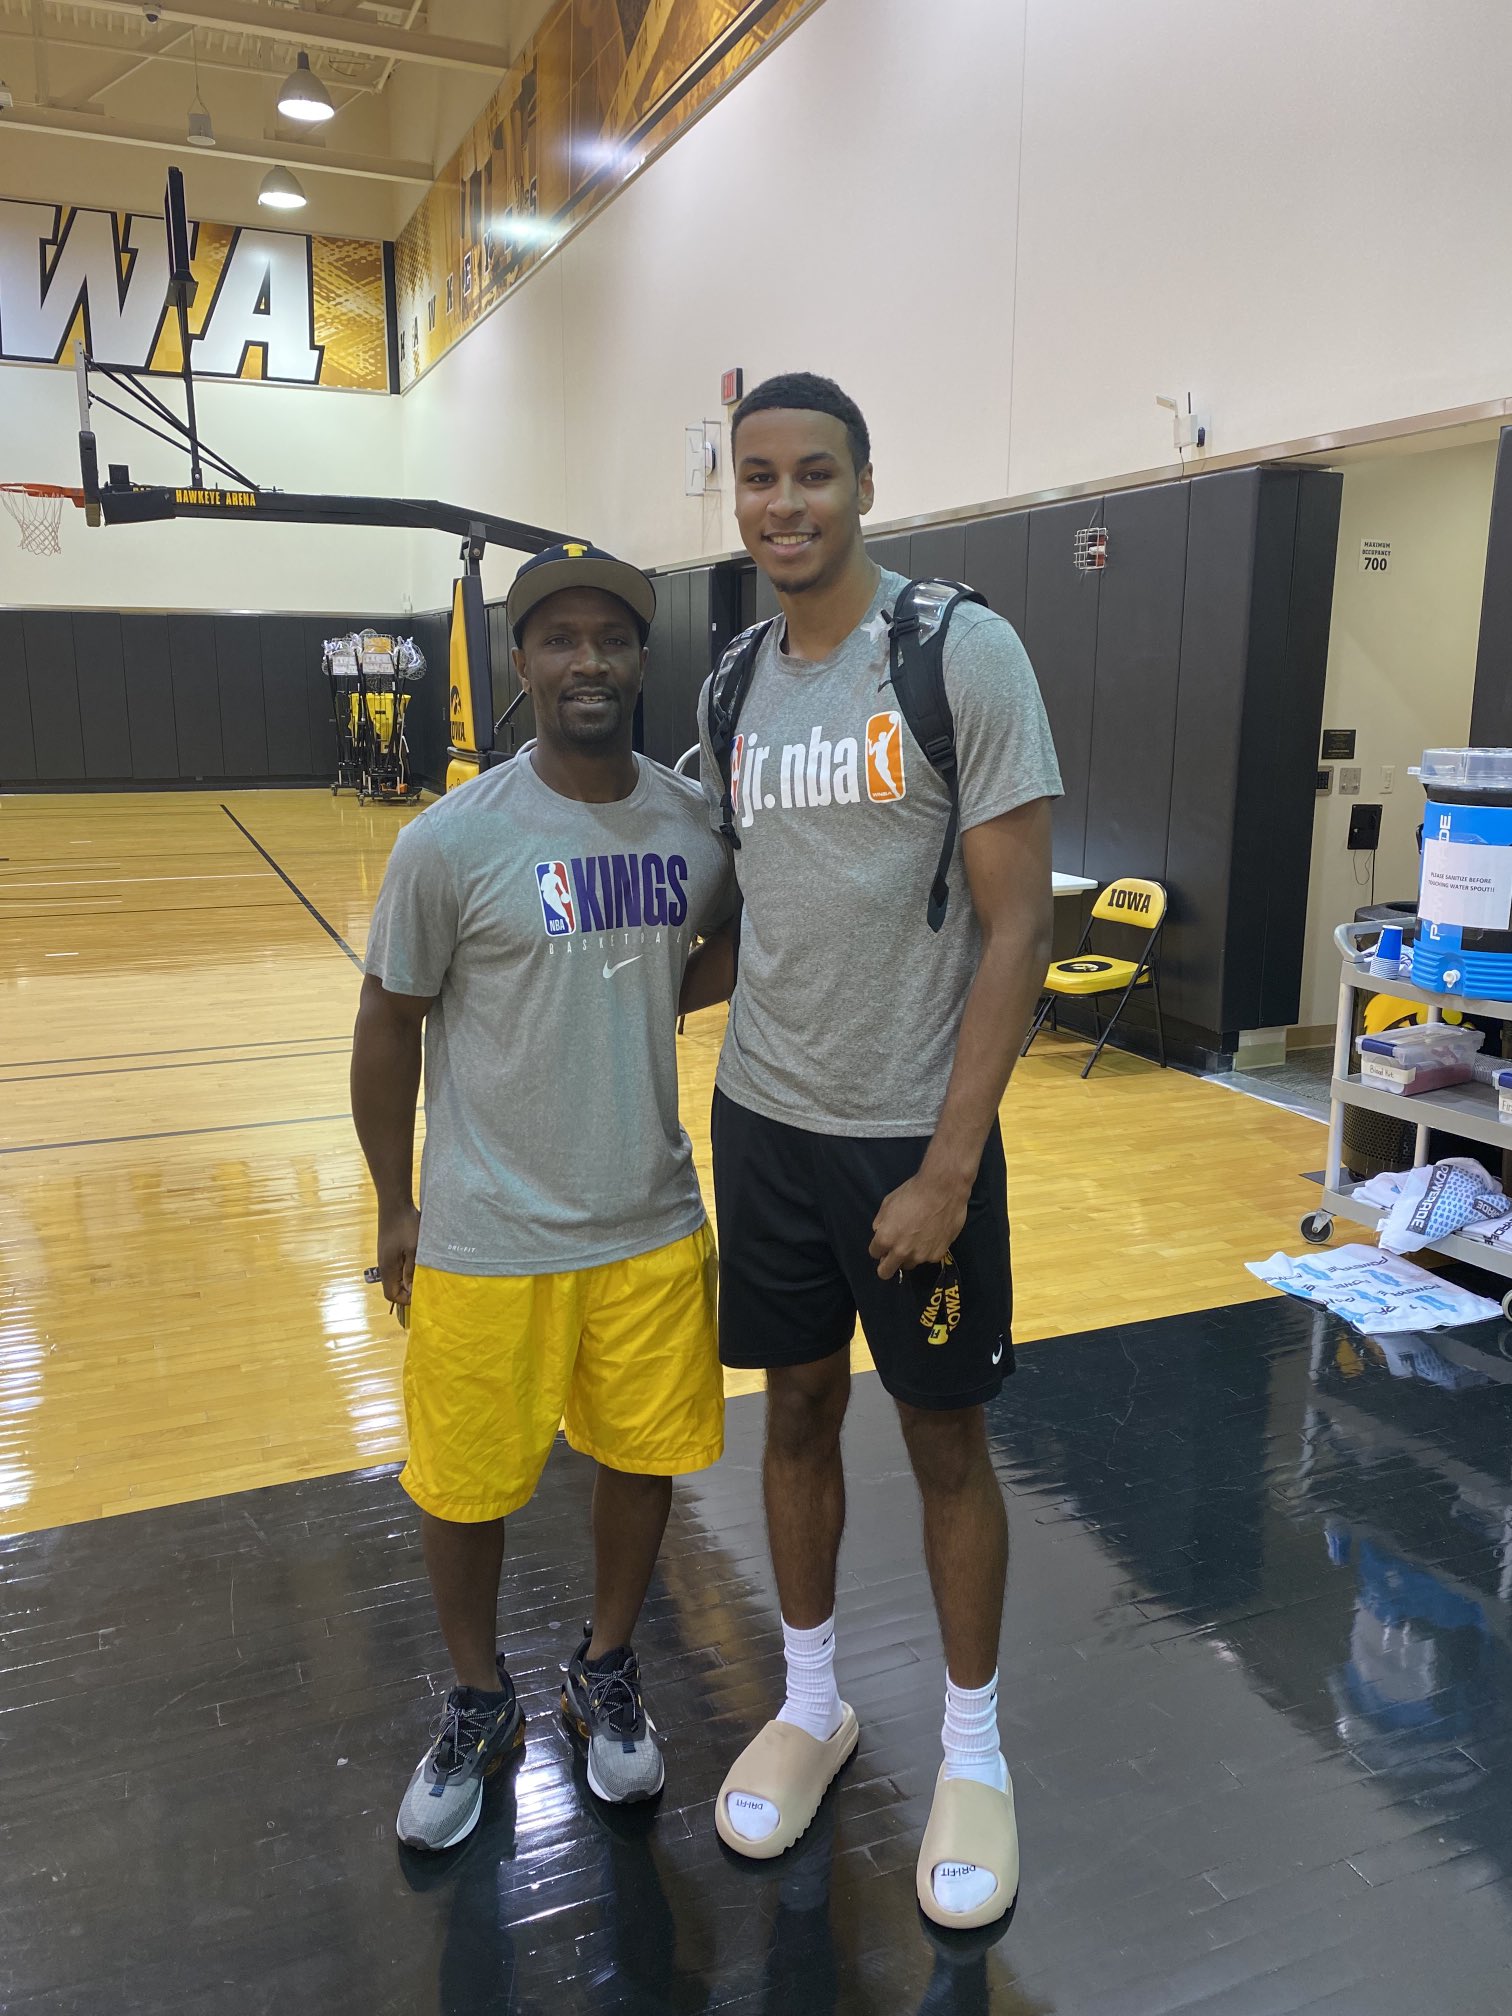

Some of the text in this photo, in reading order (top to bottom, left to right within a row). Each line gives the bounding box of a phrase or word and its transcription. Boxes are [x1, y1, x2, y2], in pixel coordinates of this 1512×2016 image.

[175, 489, 257, 507] HAWKEYE ARENA
[1364, 557, 1388, 571] 700
[1430, 872, 1444, 880] PLEASE
[1445, 874, 1468, 882] SANITIZE
[570, 852, 688, 933] KINGS
[1428, 879, 1449, 888] TOUCHING
[1470, 885, 1495, 893] SPOUT!!
[1107, 888, 1152, 914] IOWA
[549, 918, 566, 931] NBA
[447, 1244, 476, 1253] DRI-FIT
[919, 1287, 944, 1328] IOWA
[736, 1798, 764, 1811] DRI-FIT
